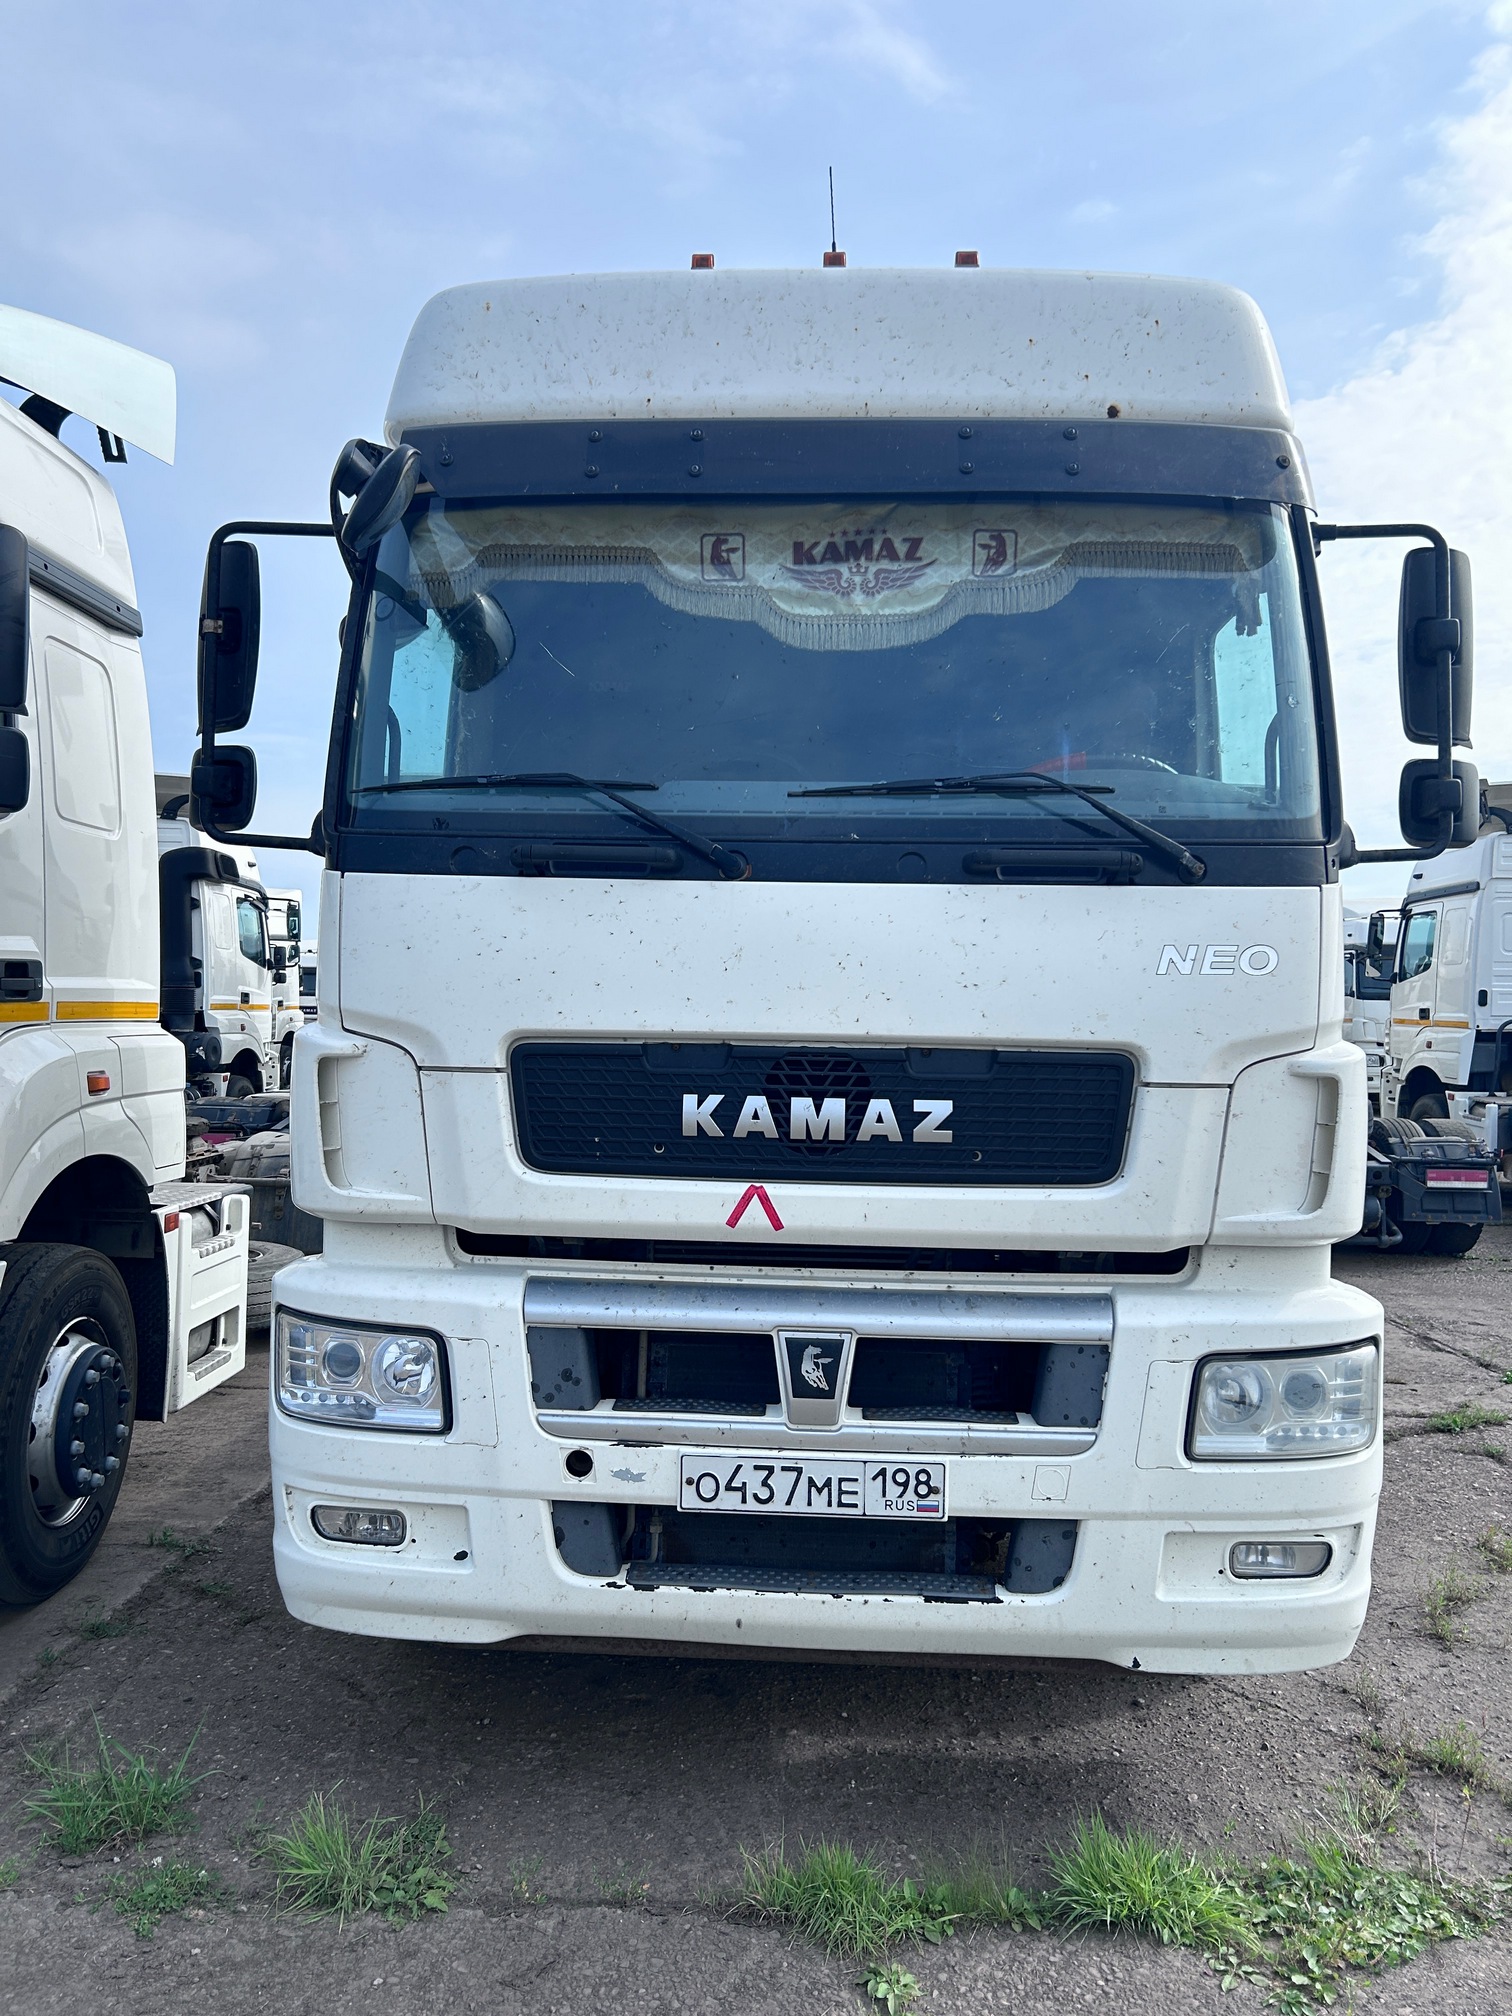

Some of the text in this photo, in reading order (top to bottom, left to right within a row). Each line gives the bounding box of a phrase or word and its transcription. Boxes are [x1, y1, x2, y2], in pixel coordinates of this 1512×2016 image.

[793, 537, 923, 565] KAMAZ
[1156, 944, 1279, 976] NEO
[682, 1094, 954, 1143] KAMAZ
[871, 1466, 932, 1499] 198
[884, 1499, 915, 1512] RUS
